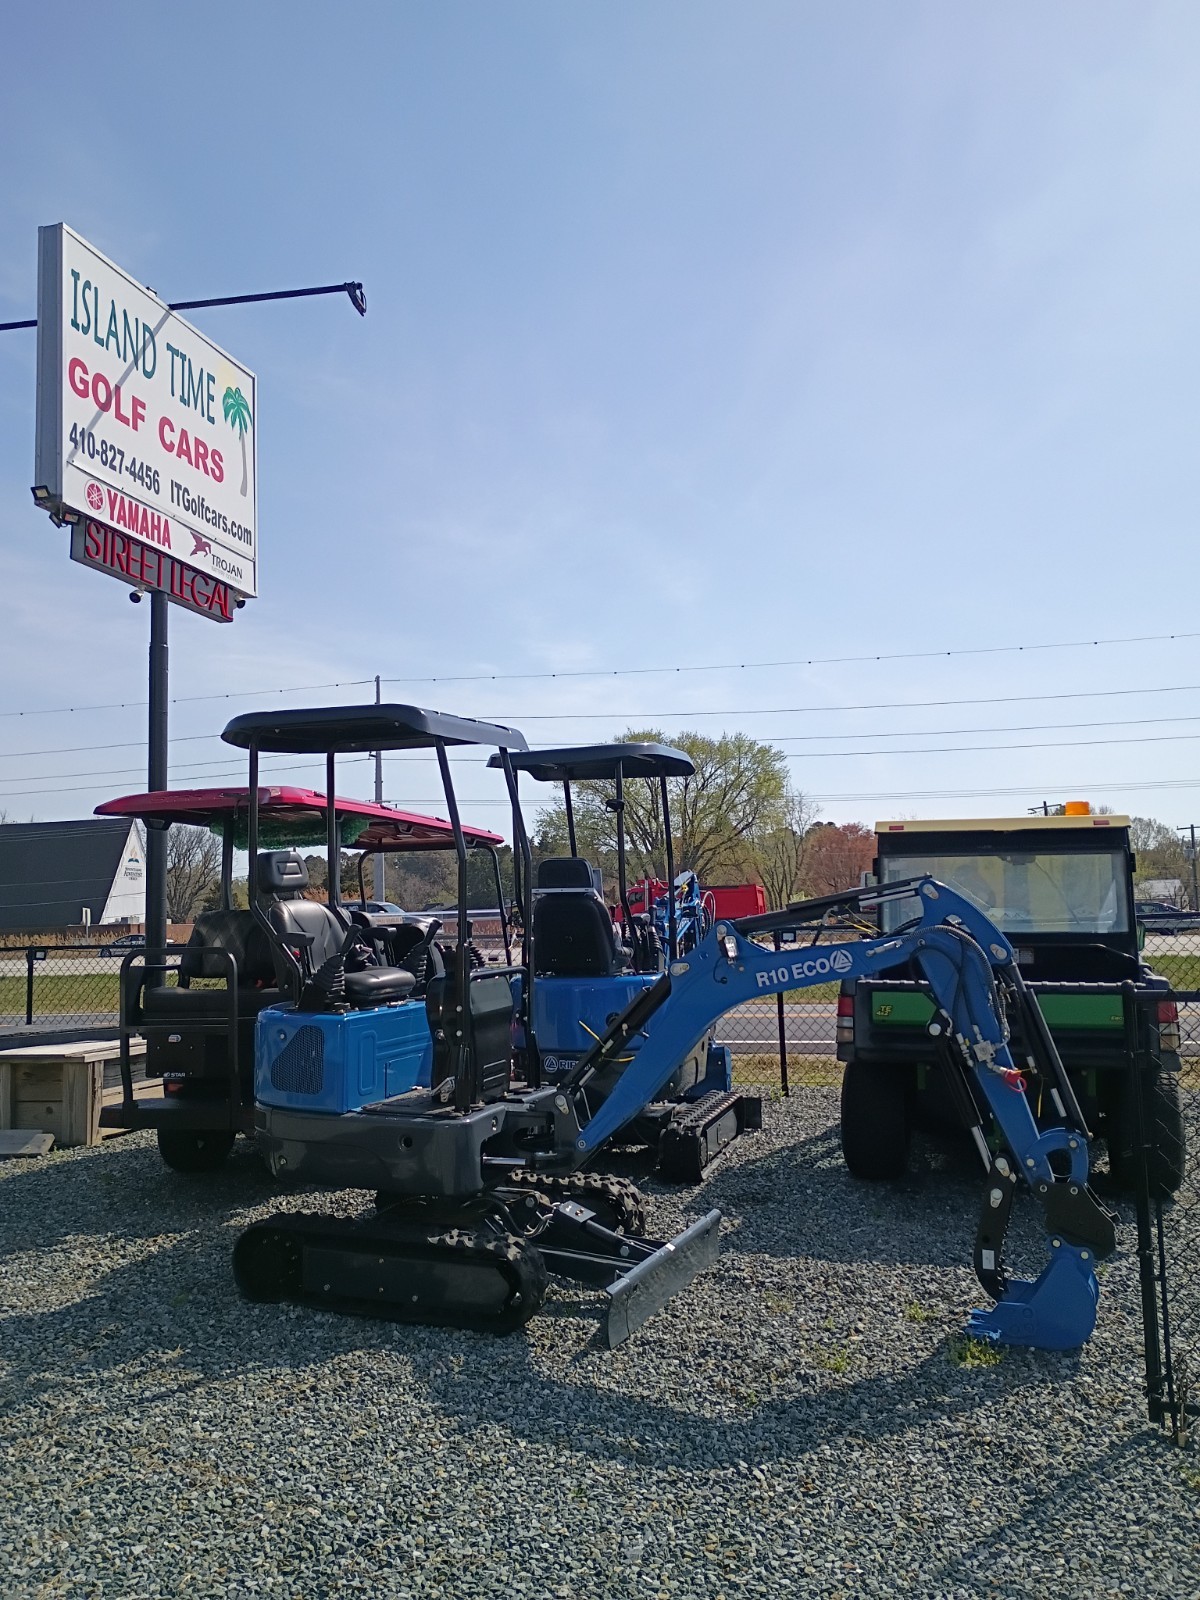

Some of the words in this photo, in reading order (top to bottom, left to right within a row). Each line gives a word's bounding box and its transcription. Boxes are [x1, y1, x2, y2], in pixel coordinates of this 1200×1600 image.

[70, 268, 157, 380] ISLAND
[166, 342, 216, 425] TIME
[68, 357, 147, 432] GOLF
[158, 416, 225, 483] CARS
[69, 422, 160, 495] 410-827-4456
[170, 479, 252, 546] ITGolfcars.com
[106, 488, 171, 550] YAMAHA
[85, 519, 166, 588] STREET
[170, 559, 234, 621] LEGAL
[211, 553, 243, 580] TROJAN
[755, 967, 789, 987] R10
[791, 958, 831, 980] ECO
